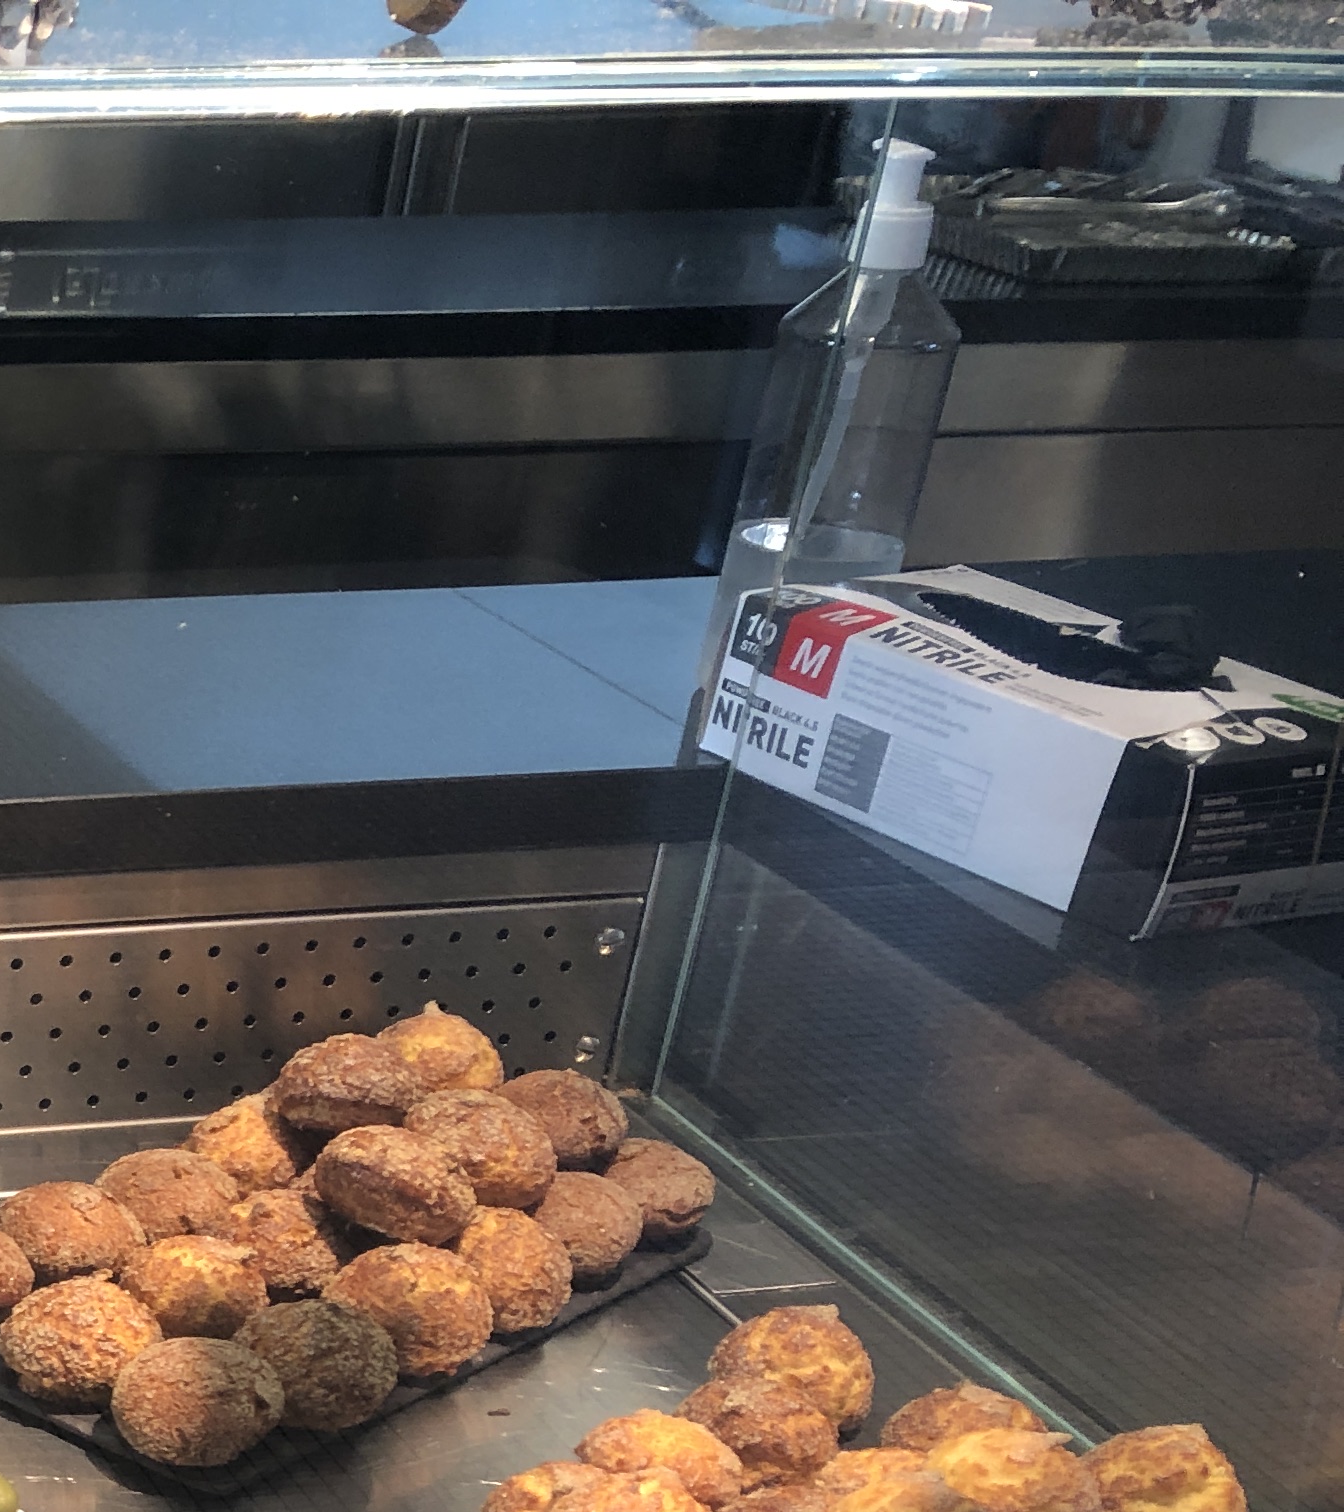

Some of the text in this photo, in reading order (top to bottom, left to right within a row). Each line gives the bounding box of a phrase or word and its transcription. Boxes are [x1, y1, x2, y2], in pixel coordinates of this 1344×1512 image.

[819, 608, 876, 626] M
[790, 637, 833, 679] M
[870, 626, 1016, 684] NITRILE
[712, 695, 815, 769] NIRILE
